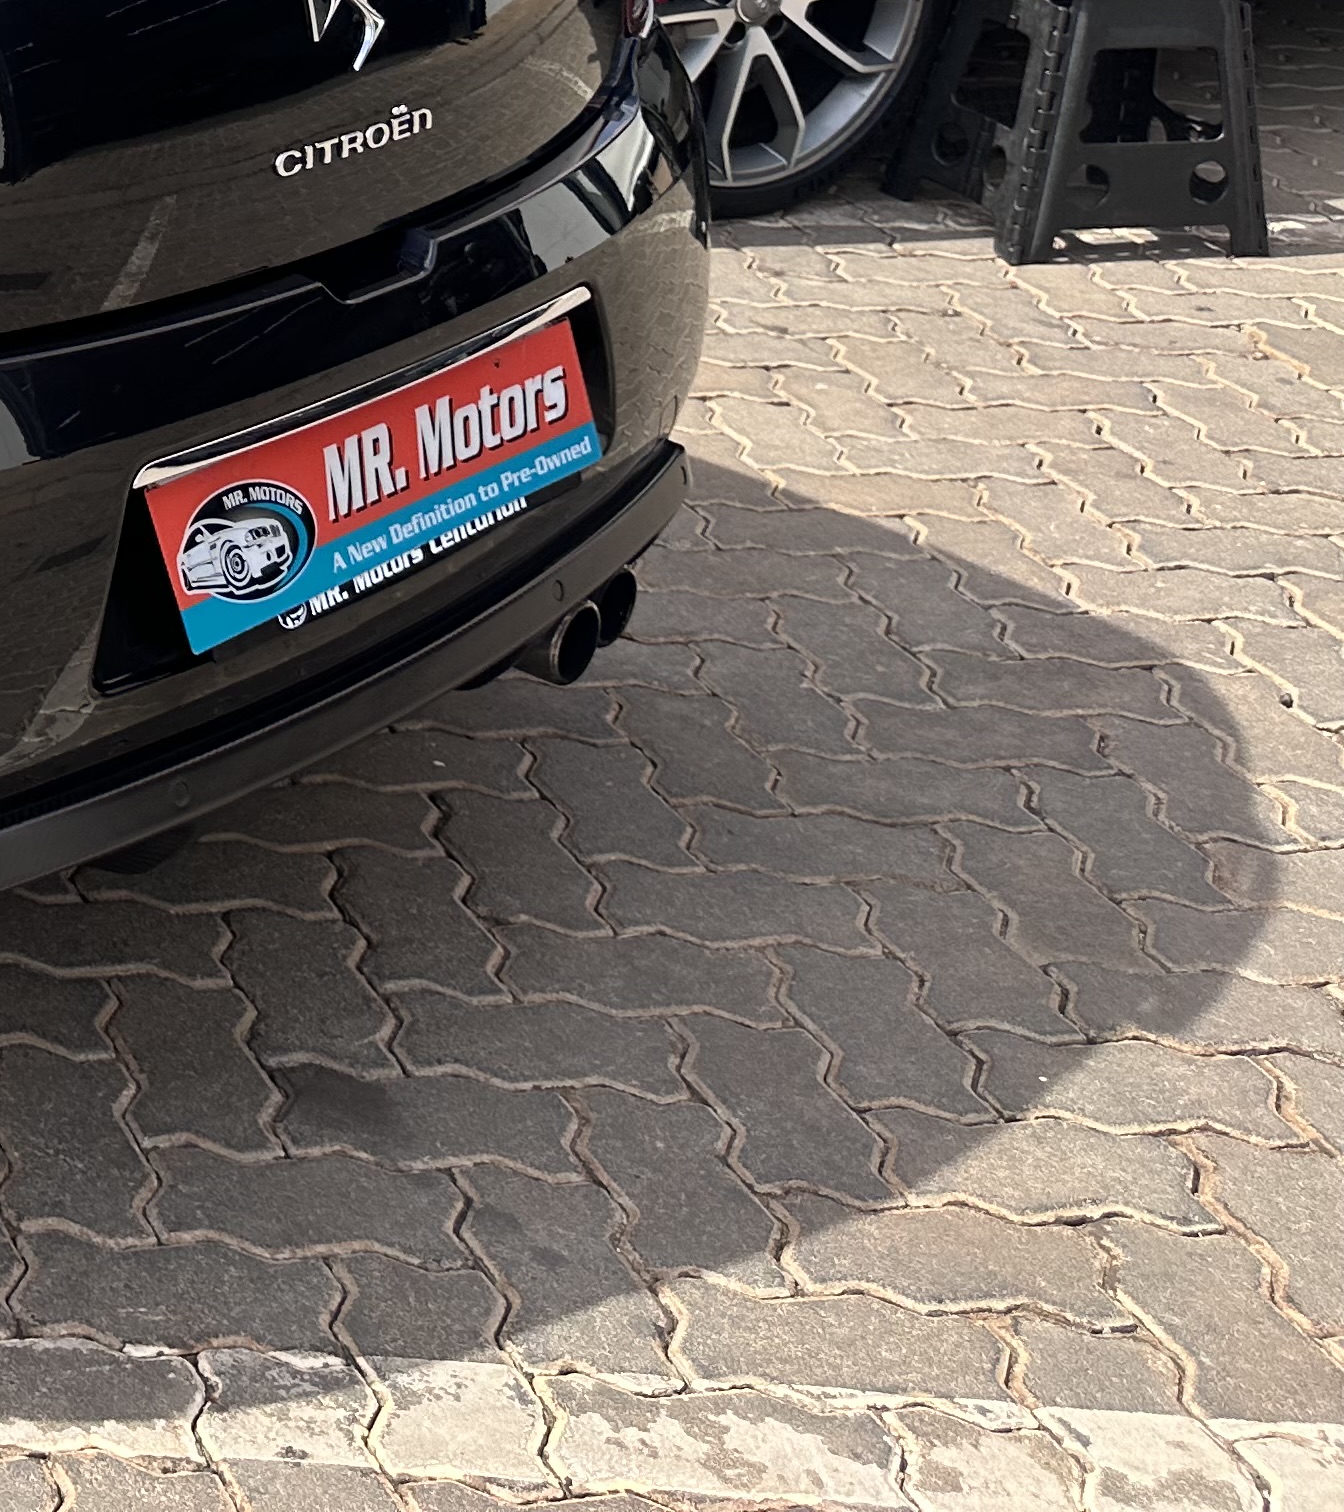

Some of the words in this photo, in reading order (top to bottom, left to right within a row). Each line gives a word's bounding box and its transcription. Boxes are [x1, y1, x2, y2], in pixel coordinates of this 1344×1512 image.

[274, 103, 433, 177] CITROËN
[322, 422, 409, 522] MR.
[414, 365, 567, 480] Motors
[222, 489, 248, 510] MR.
[248, 486, 304, 515] MOTORS
[333, 551, 347, 575] A
[347, 533, 387, 564] New
[387, 491, 478, 545] Definition
[477, 482, 500, 502] to
[500, 436, 593, 492] Pre-Owned
[352, 546, 423, 593] Motors
